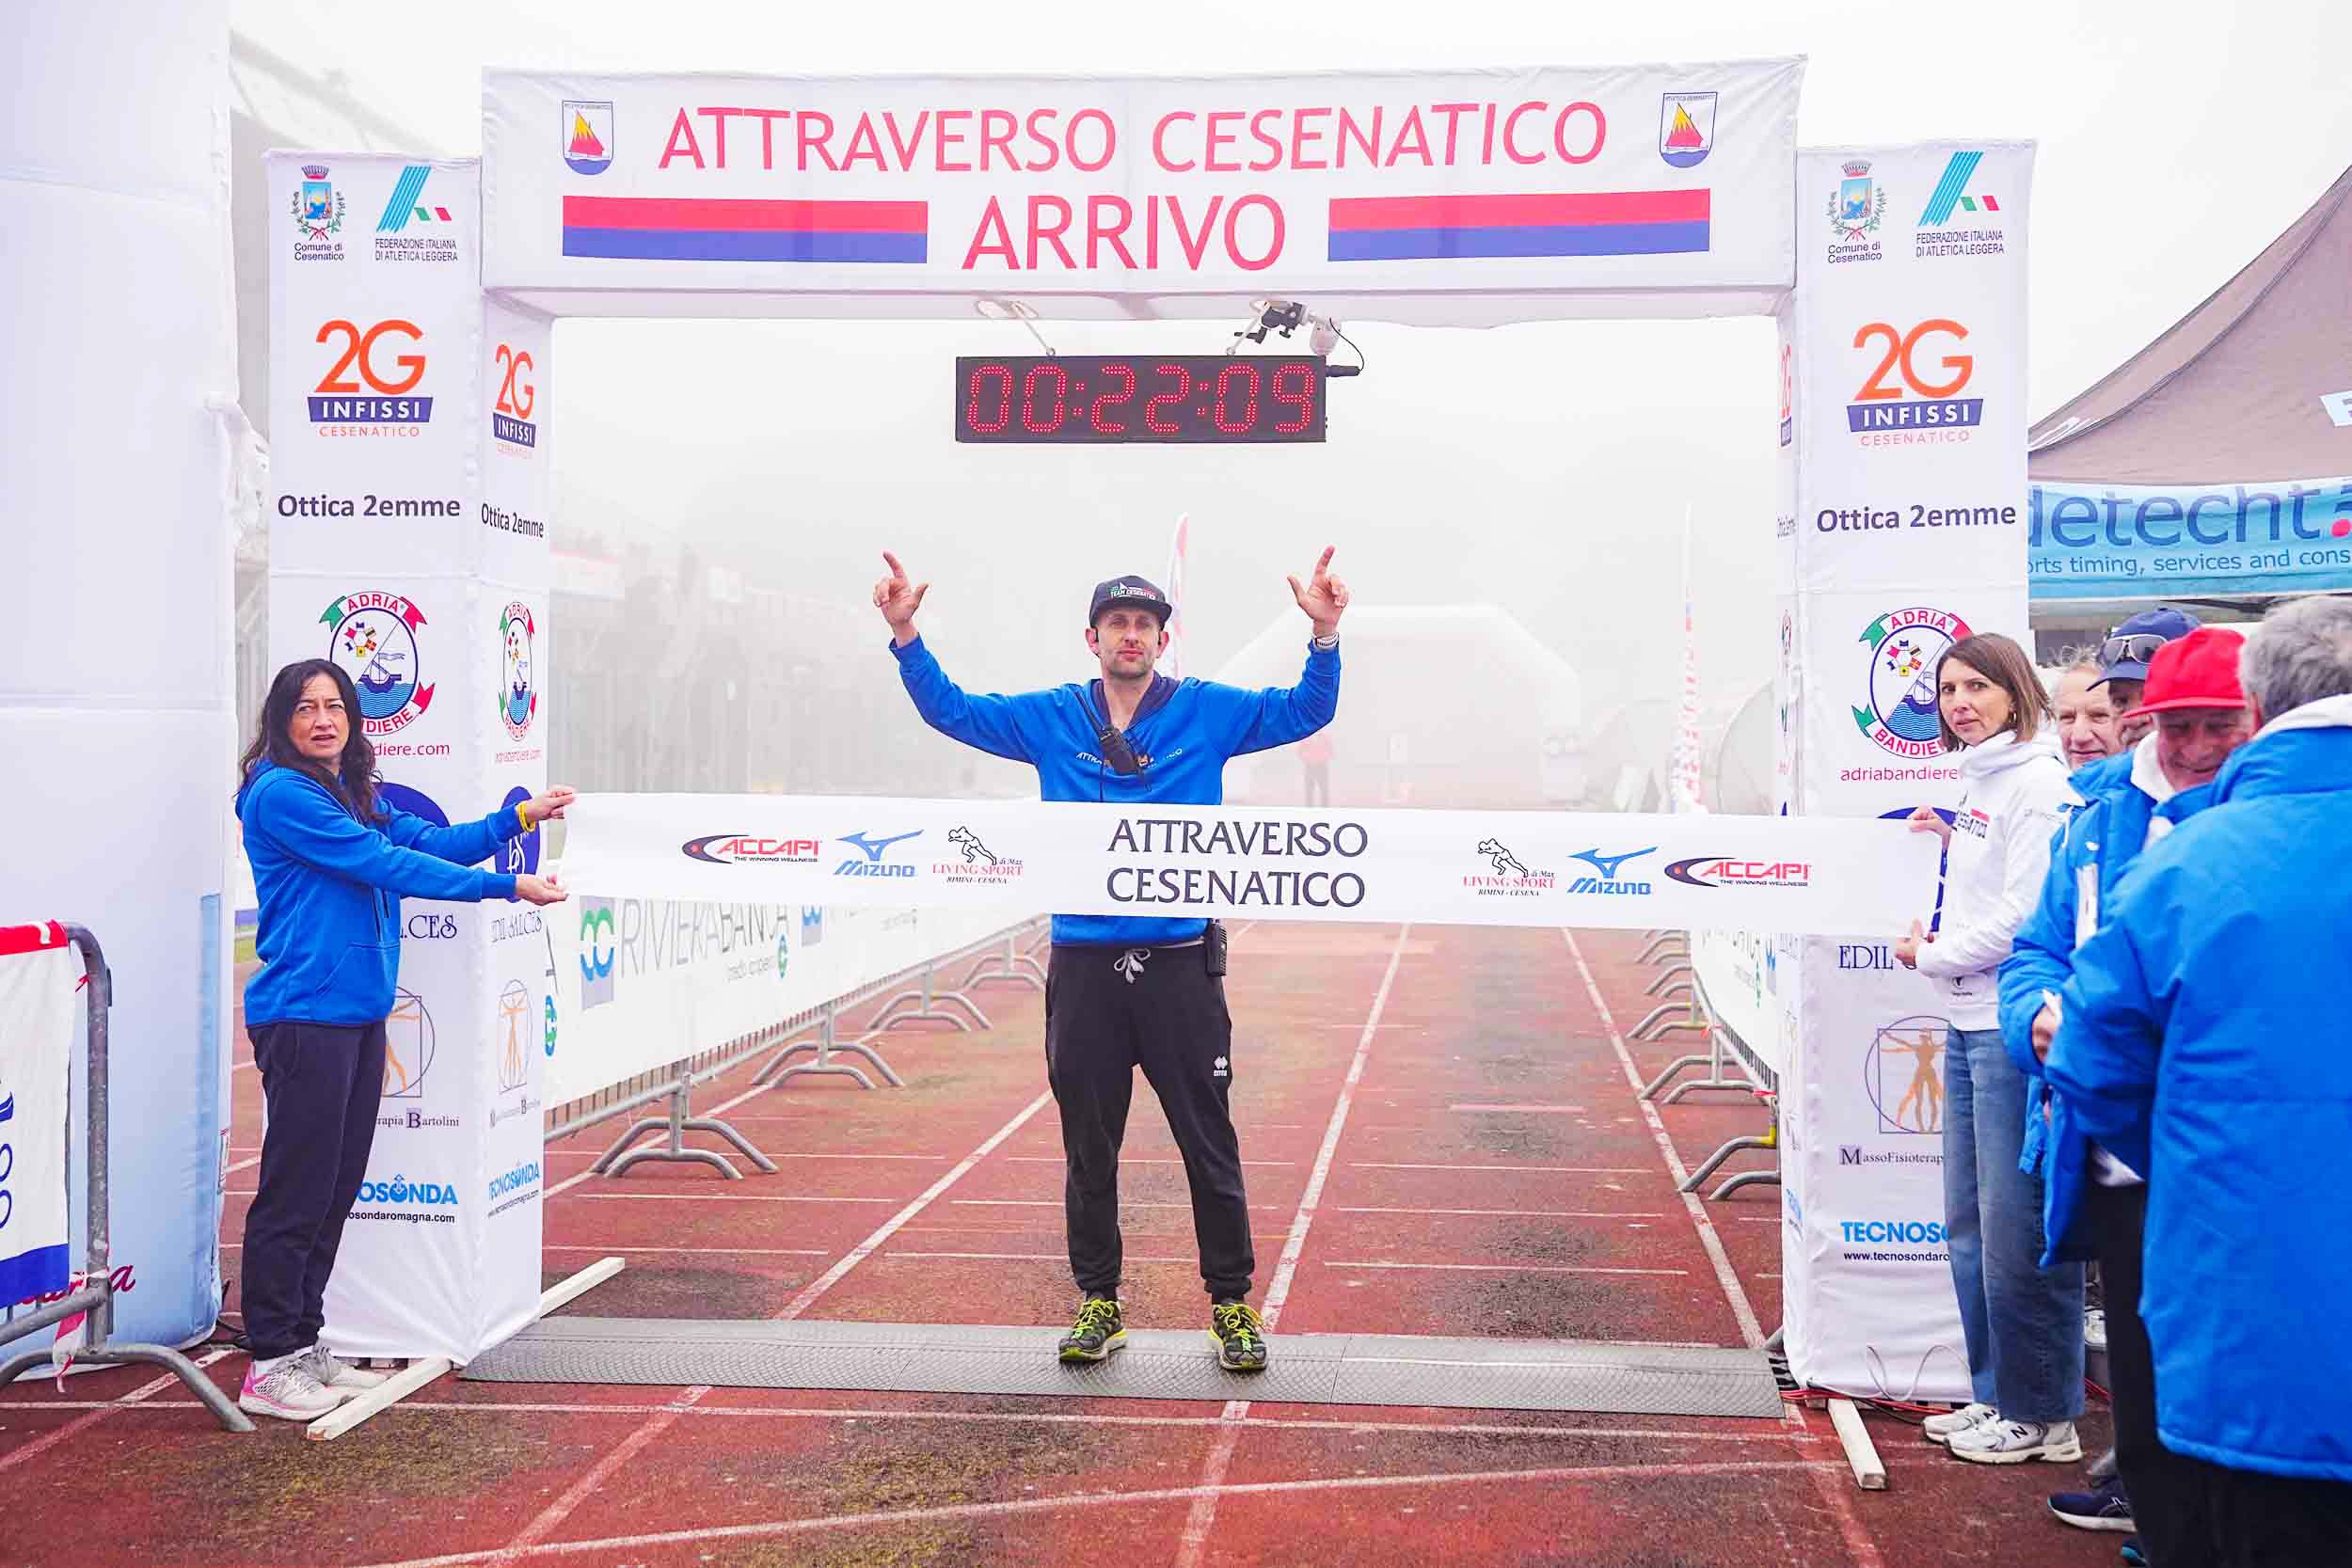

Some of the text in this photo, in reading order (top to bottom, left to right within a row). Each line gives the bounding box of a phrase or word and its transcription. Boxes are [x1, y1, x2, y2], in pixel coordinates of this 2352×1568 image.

[659, 101, 1607, 172] ATTRAVERSO CESENATICO
[961, 193, 1285, 271] ARRIVO
[1916, 230, 2003, 245] FEDERAZIONE ITALIANA
[294, 242, 342, 251] Comune di
[375, 239, 456, 250] FEDERAZIONE ITALIANA
[1828, 241, 1881, 255] Comune di
[1916, 243, 2004, 258] DI ATLETICA LEGGERA
[294, 251, 344, 261] Cesenatico
[375, 251, 458, 261] DI ATLETICA LEGGERA
[1828, 252, 1882, 263] Cesenatico
[315, 319, 426, 395] 2G
[1852, 319, 1973, 402] 2G
[496, 344, 534, 420] 2G
[967, 364, 1317, 434] 00:22:09
[322, 401, 420, 419] INFISSI
[1863, 404, 1969, 428] INFISSI
[319, 426, 420, 437] CESENATICO
[498, 419, 532, 443] INFISSI
[1861, 430, 1970, 447] CESENATICO
[278, 495, 461, 517] Ottica 2emme
[482, 502, 544, 538] Ottica 2emme
[1817, 506, 1899, 532] Ottica
[1909, 504, 2016, 528] 2emme
[2028, 548, 2351, 578] orts timing, services and cons
[348, 594, 399, 613] ADRIA
[1891, 610, 1947, 630] ADRIA
[362, 707, 413, 733] DIERE
[373, 742, 451, 757] diere.com
[1840, 766, 1963, 782] adriabandiere.
[1106, 818, 1368, 858] ATTRAVERSO
[717, 839, 820, 857] ACCAPI
[932, 863, 1024, 877] LIVING SPORT
[1700, 861, 1809, 879] ACCAPI
[1106, 867, 1366, 908] CESENATICO
[1463, 876, 1555, 889] LIVING SPORT
[1839, 944, 1894, 970] EDIL
[405, 1112, 459, 1129] Bartolini
[1840, 1146, 1943, 1166] MassoFisioterap
[358, 1181, 458, 1205] OSONDA
[346, 1210, 455, 1224] osondaromagna.com
[1843, 1250, 1950, 1262] www.tecnosondaro
